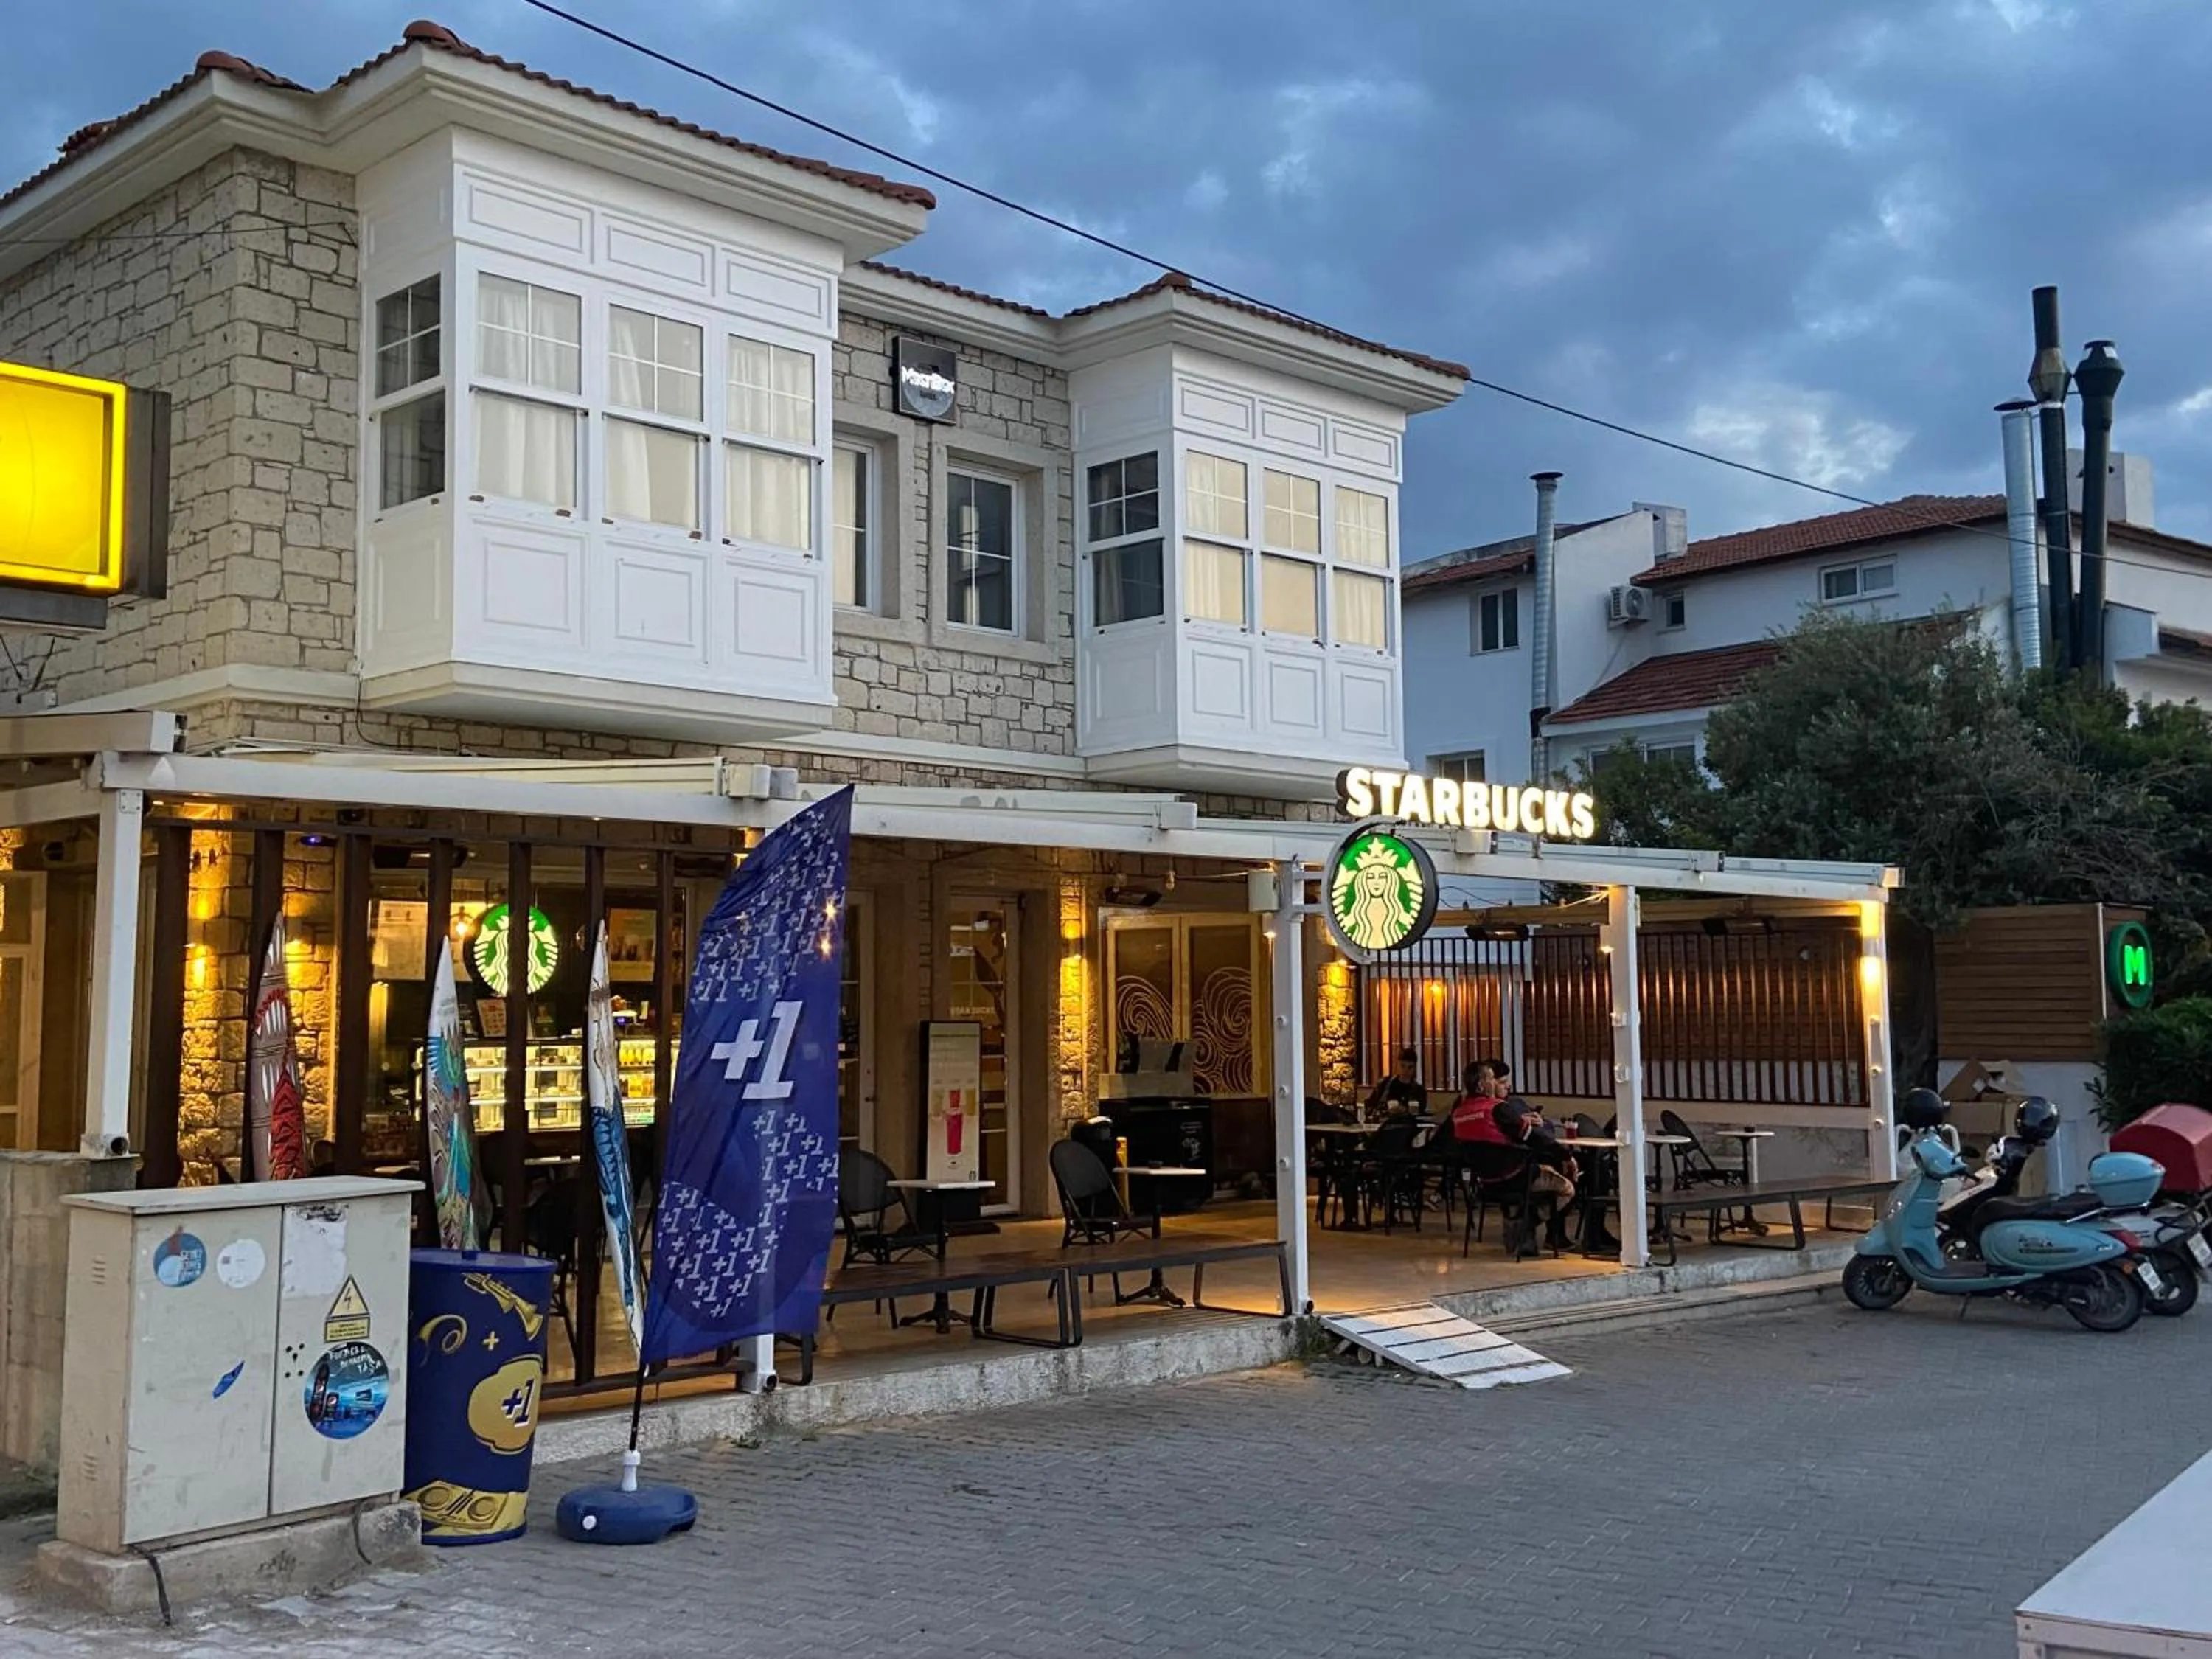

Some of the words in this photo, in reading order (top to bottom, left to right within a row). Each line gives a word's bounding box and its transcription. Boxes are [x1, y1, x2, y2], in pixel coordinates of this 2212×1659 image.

[1343, 766, 1596, 839] STARBUCKS
[2124, 945, 2146, 986] M
[710, 1001, 803, 1099] +1
[753, 1110, 776, 1135] +1
[768, 1132, 790, 1157] +1
[784, 1154, 807, 1179] +1
[766, 1178, 790, 1203] +1
[661, 1207, 683, 1233] +1
[696, 1228, 720, 1253] +1
[731, 1226, 756, 1252] +1
[678, 1253, 702, 1279] +1
[712, 1251, 737, 1276] +1
[746, 1248, 771, 1273] +1
[694, 1276, 719, 1301] +1
[728, 1273, 753, 1297] +1
[501, 1379, 535, 1427] +1
